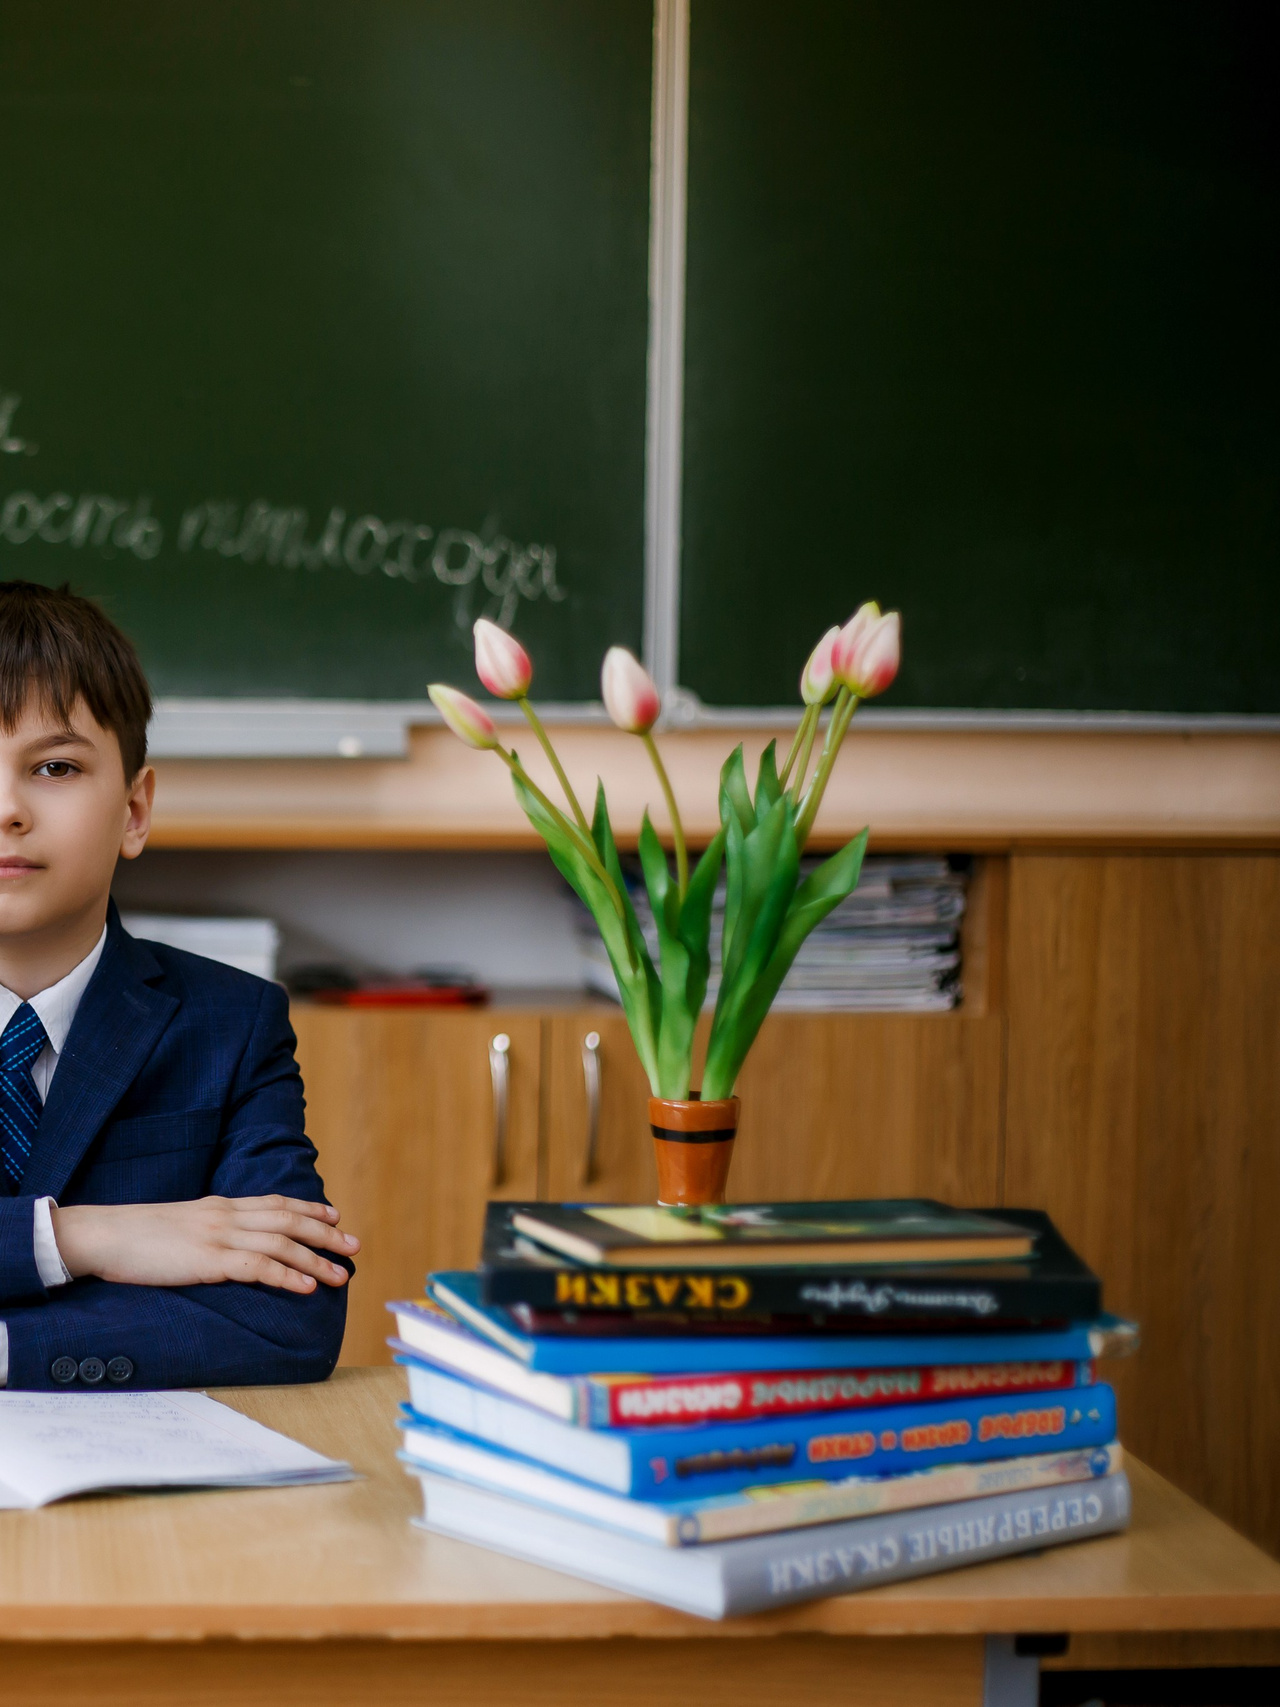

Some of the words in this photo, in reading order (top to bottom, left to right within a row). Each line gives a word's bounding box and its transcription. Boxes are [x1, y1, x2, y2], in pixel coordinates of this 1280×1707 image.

[555, 1272, 751, 1310] СКАЗКИ
[750, 1371, 921, 1408] НАРОДНЫЕ
[930, 1360, 1065, 1392] РУССКИЕ
[618, 1385, 744, 1418] СКАЗКИ
[910, 1493, 1104, 1564] СЕРЕБРЯНЫЕ
[768, 1532, 899, 1594] СКАЗКИ
